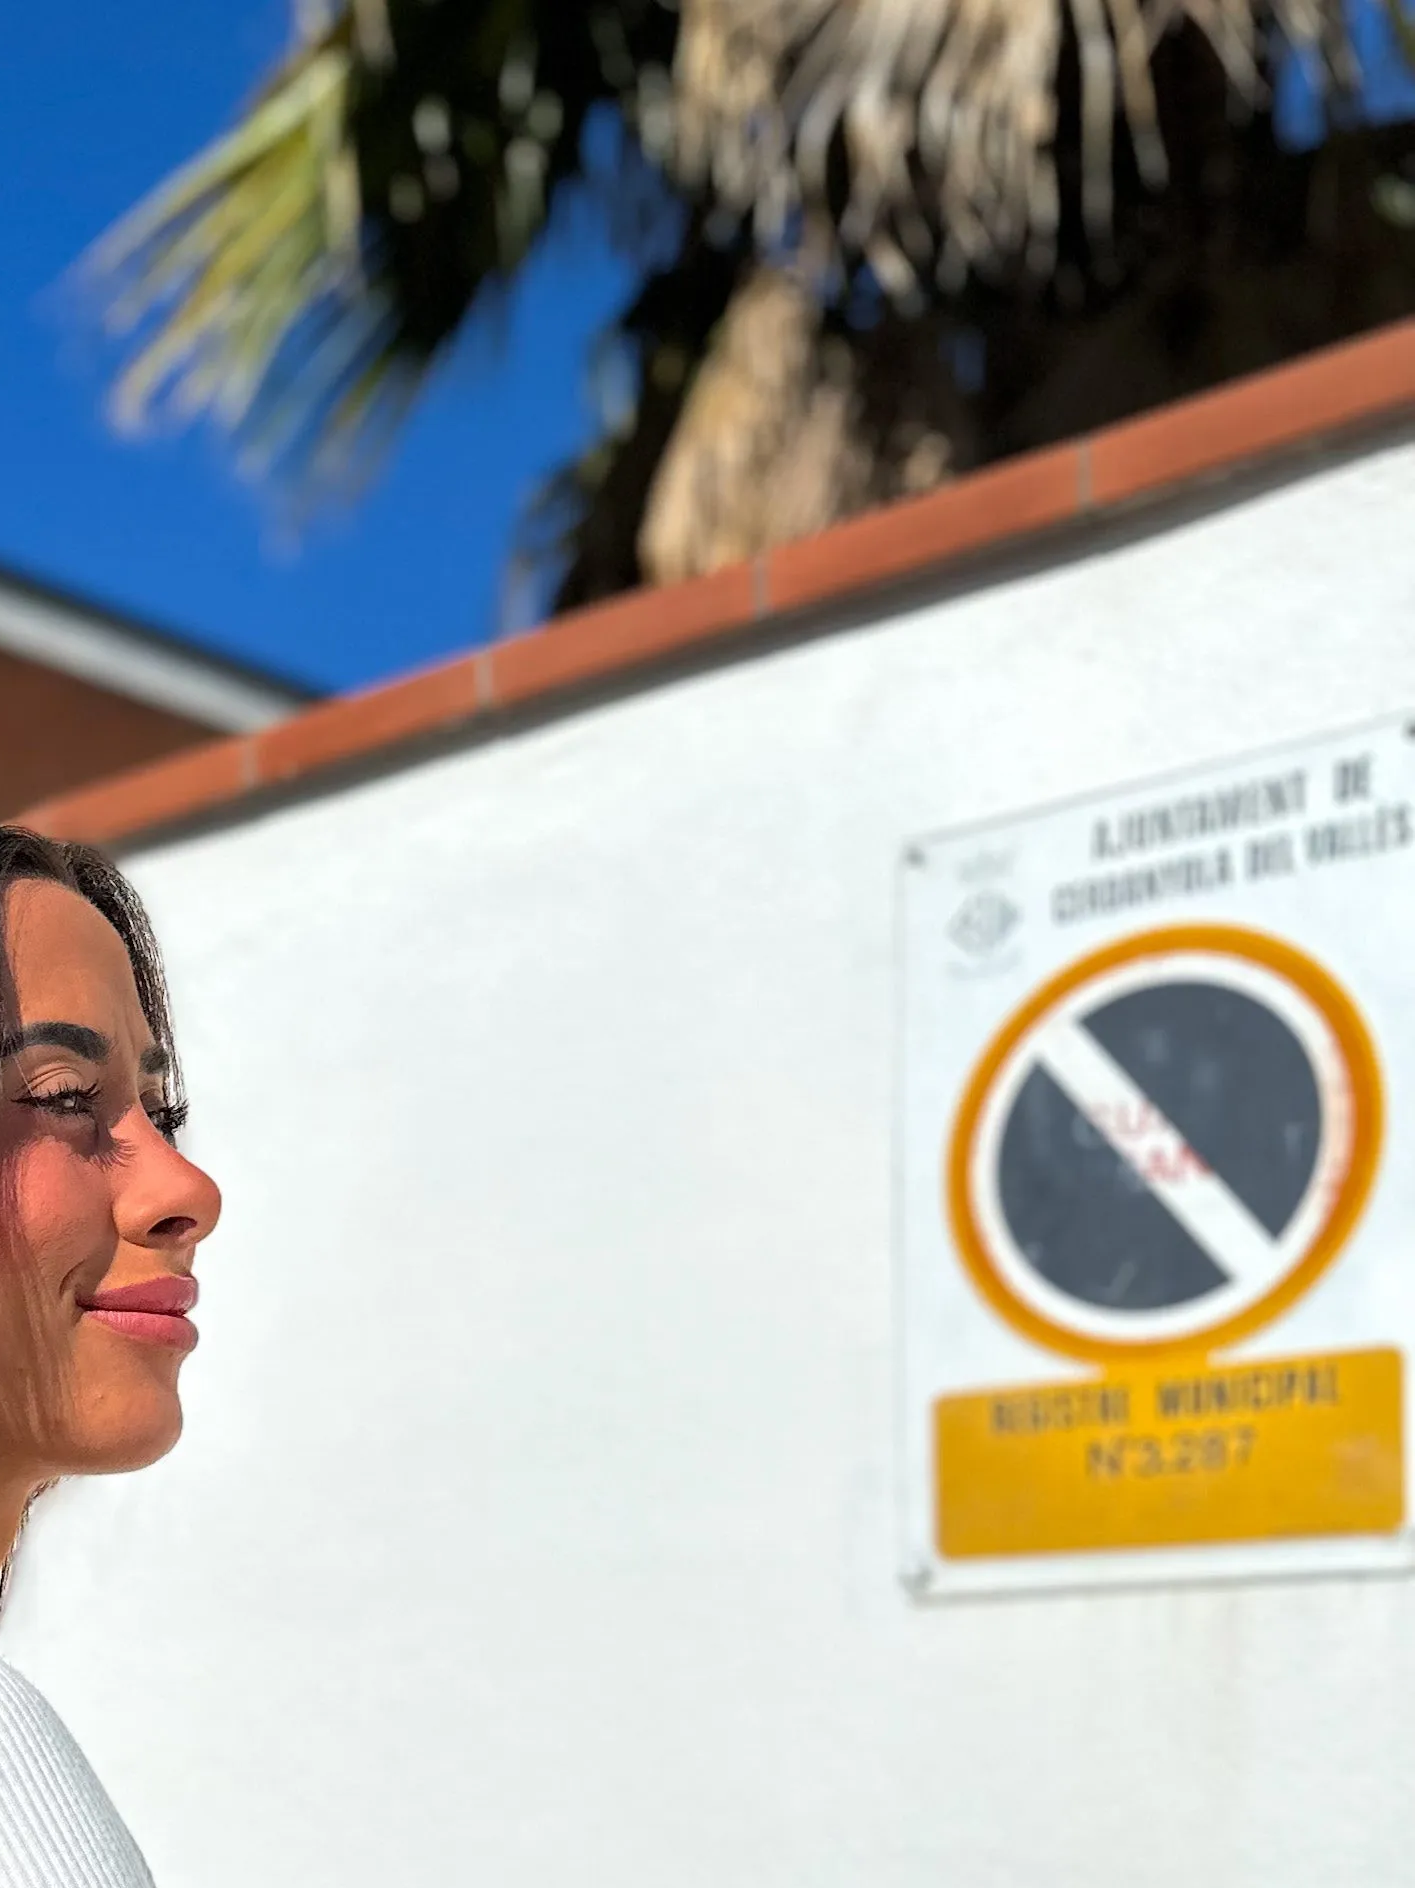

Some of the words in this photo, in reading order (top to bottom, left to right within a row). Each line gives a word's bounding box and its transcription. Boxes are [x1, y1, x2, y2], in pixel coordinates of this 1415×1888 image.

[1092, 766, 1308, 860] AJUNTAMENT
[1332, 752, 1377, 804] DE
[1155, 1364, 1340, 1418] MUNICIPAL
